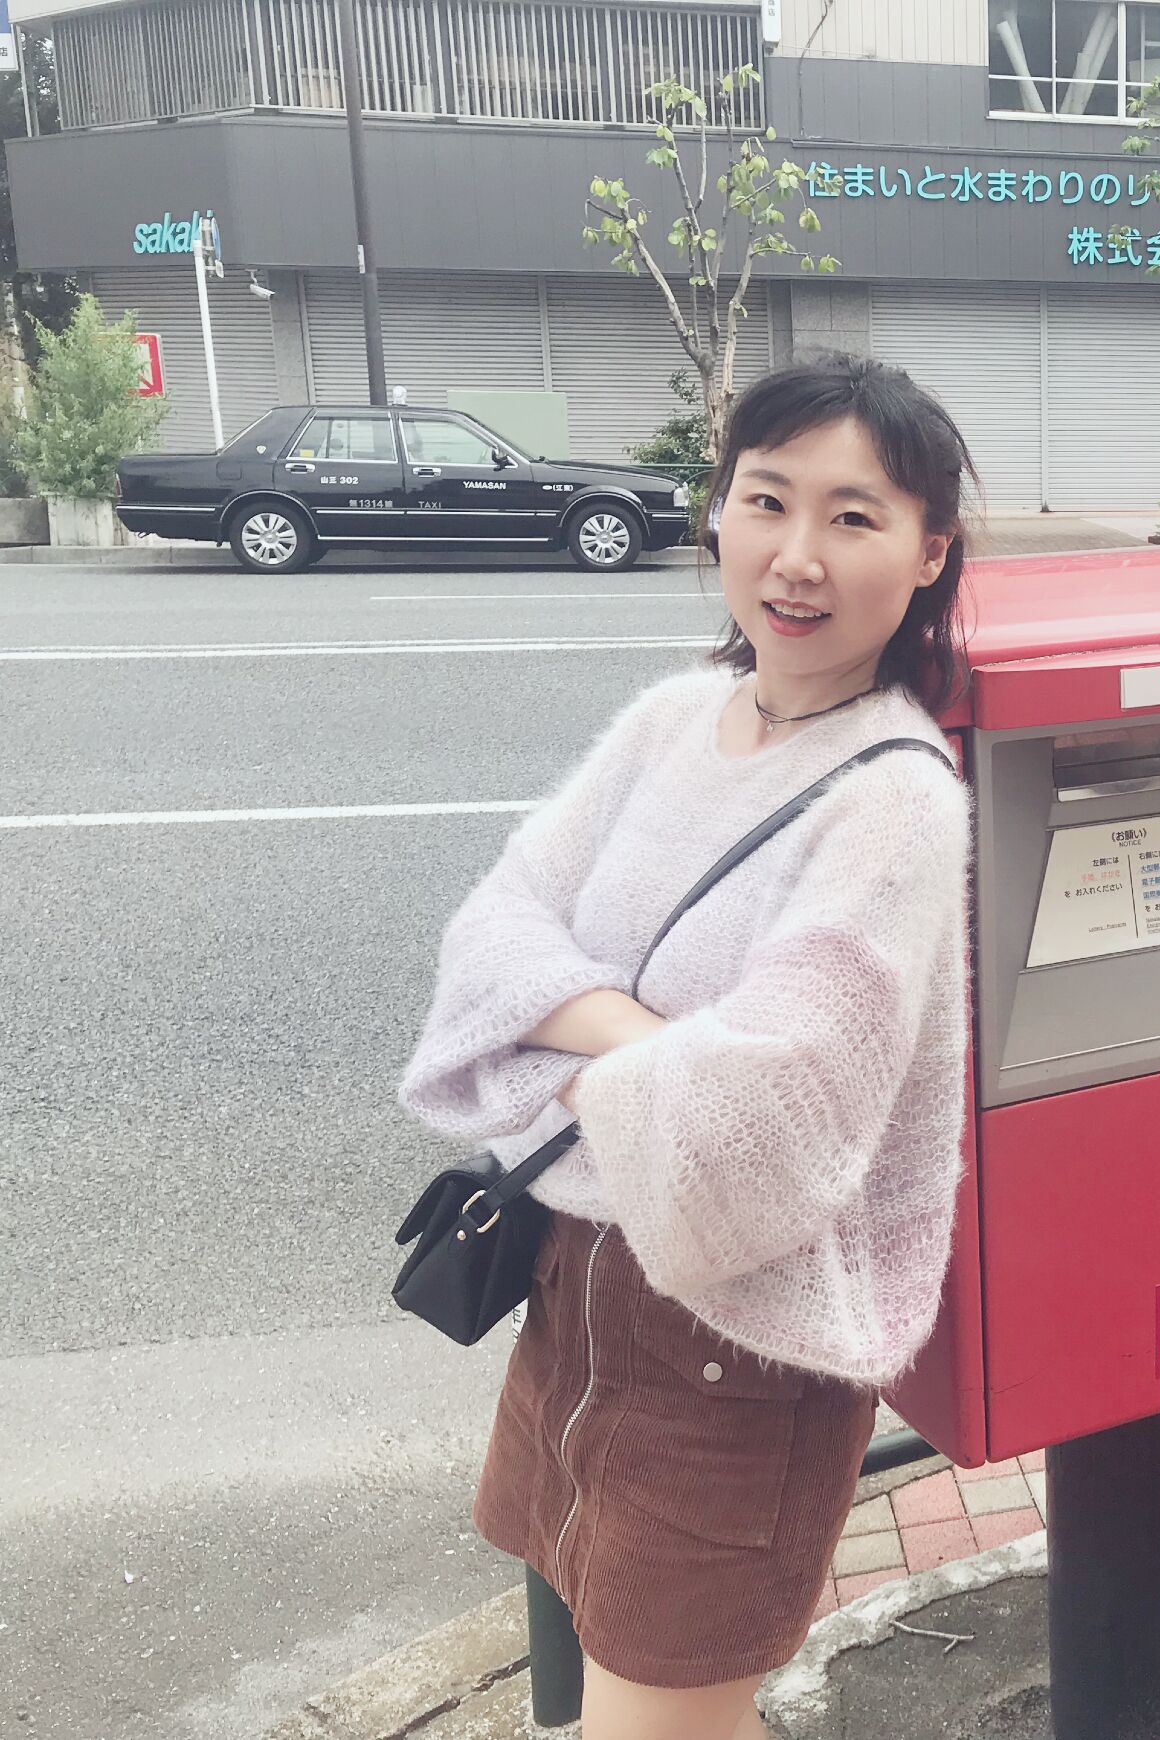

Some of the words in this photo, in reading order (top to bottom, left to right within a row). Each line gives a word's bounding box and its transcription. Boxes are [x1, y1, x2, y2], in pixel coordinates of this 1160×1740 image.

[340, 476, 359, 485] 302
[463, 481, 506, 490] YAMASAN
[418, 501, 442, 509] TAXI
[1118, 839, 1142, 848] NOTICE
[1092, 856, 1119, 867] 左側には
